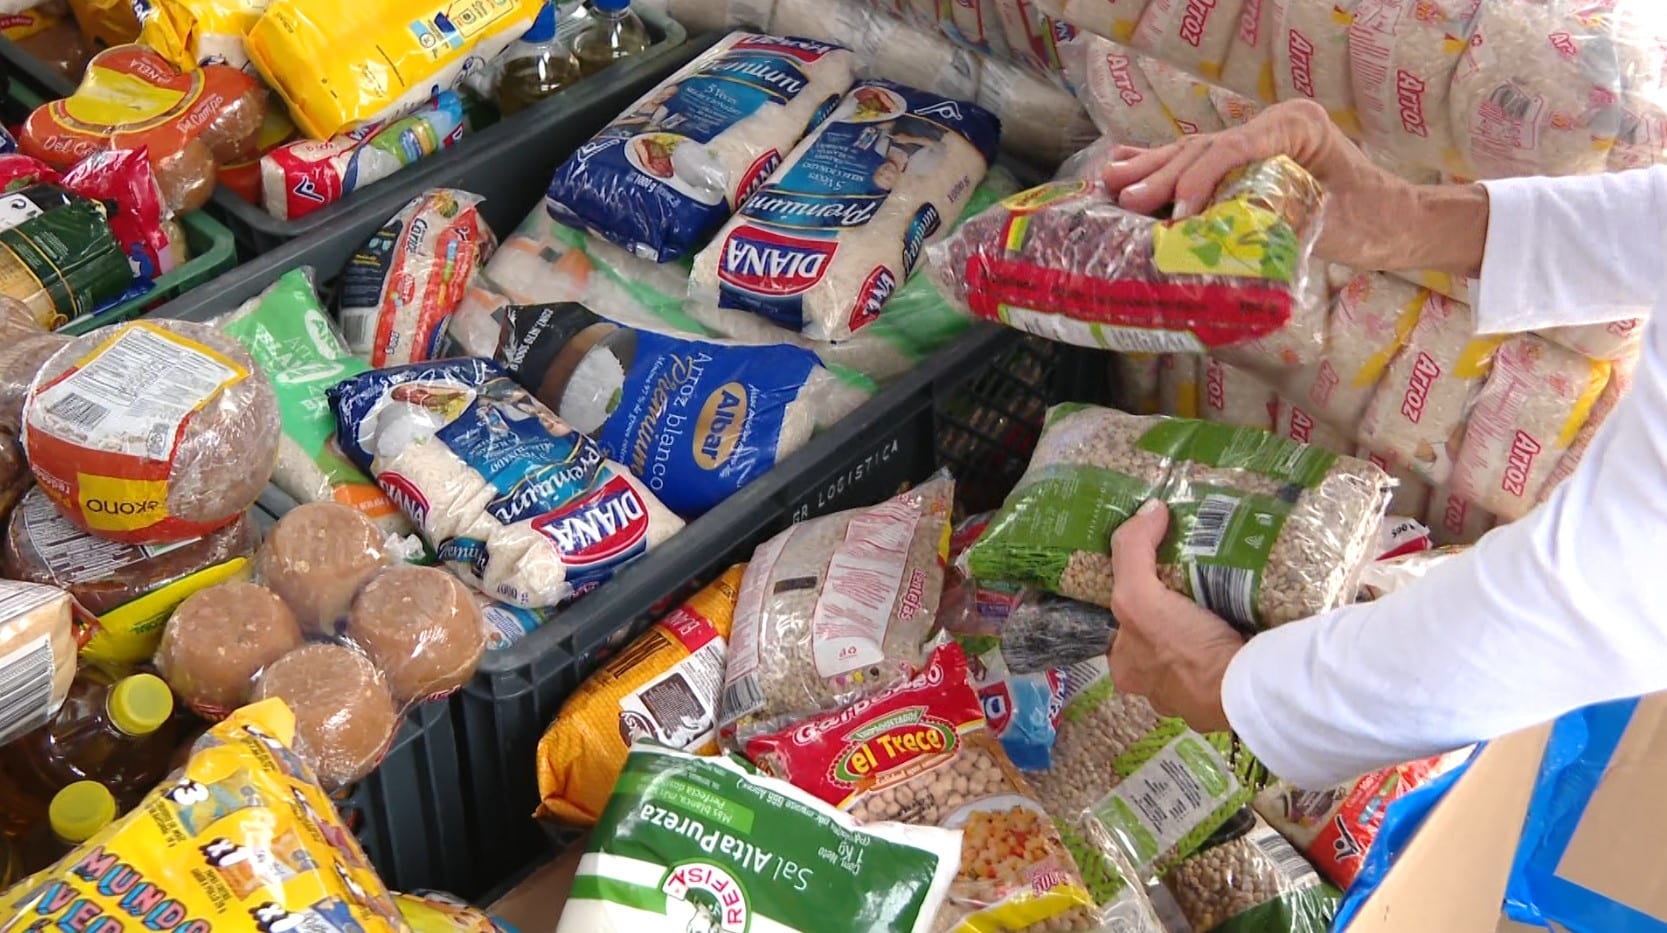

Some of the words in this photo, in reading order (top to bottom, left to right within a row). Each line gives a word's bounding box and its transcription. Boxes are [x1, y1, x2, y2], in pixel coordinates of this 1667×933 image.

[1240, 0, 1263, 47] rroz
[1289, 29, 1314, 98] Arroz
[190, 94, 224, 126] Campo
[1397, 69, 1429, 138] Arroz
[749, 195, 876, 226] Premium
[727, 238, 828, 279] DIANA
[673, 352, 713, 408] Arroz
[1402, 351, 1440, 424] Arroz
[631, 353, 693, 475] Premium
[701, 389, 740, 461] Albar
[1290, 407, 1315, 443] Arr
[651, 414, 688, 491] blanco
[817, 439, 898, 508] LOGISTICA
[1503, 430, 1540, 496] Arroz
[86, 498, 159, 516] ekono
[495, 444, 601, 521] Premium
[541, 489, 644, 552] DIANA
[900, 568, 927, 621] Lentejas
[852, 744, 878, 773] el
[877, 729, 942, 758] Trece
[772, 856, 814, 891] Sal
[838, 841, 855, 863] Kg
